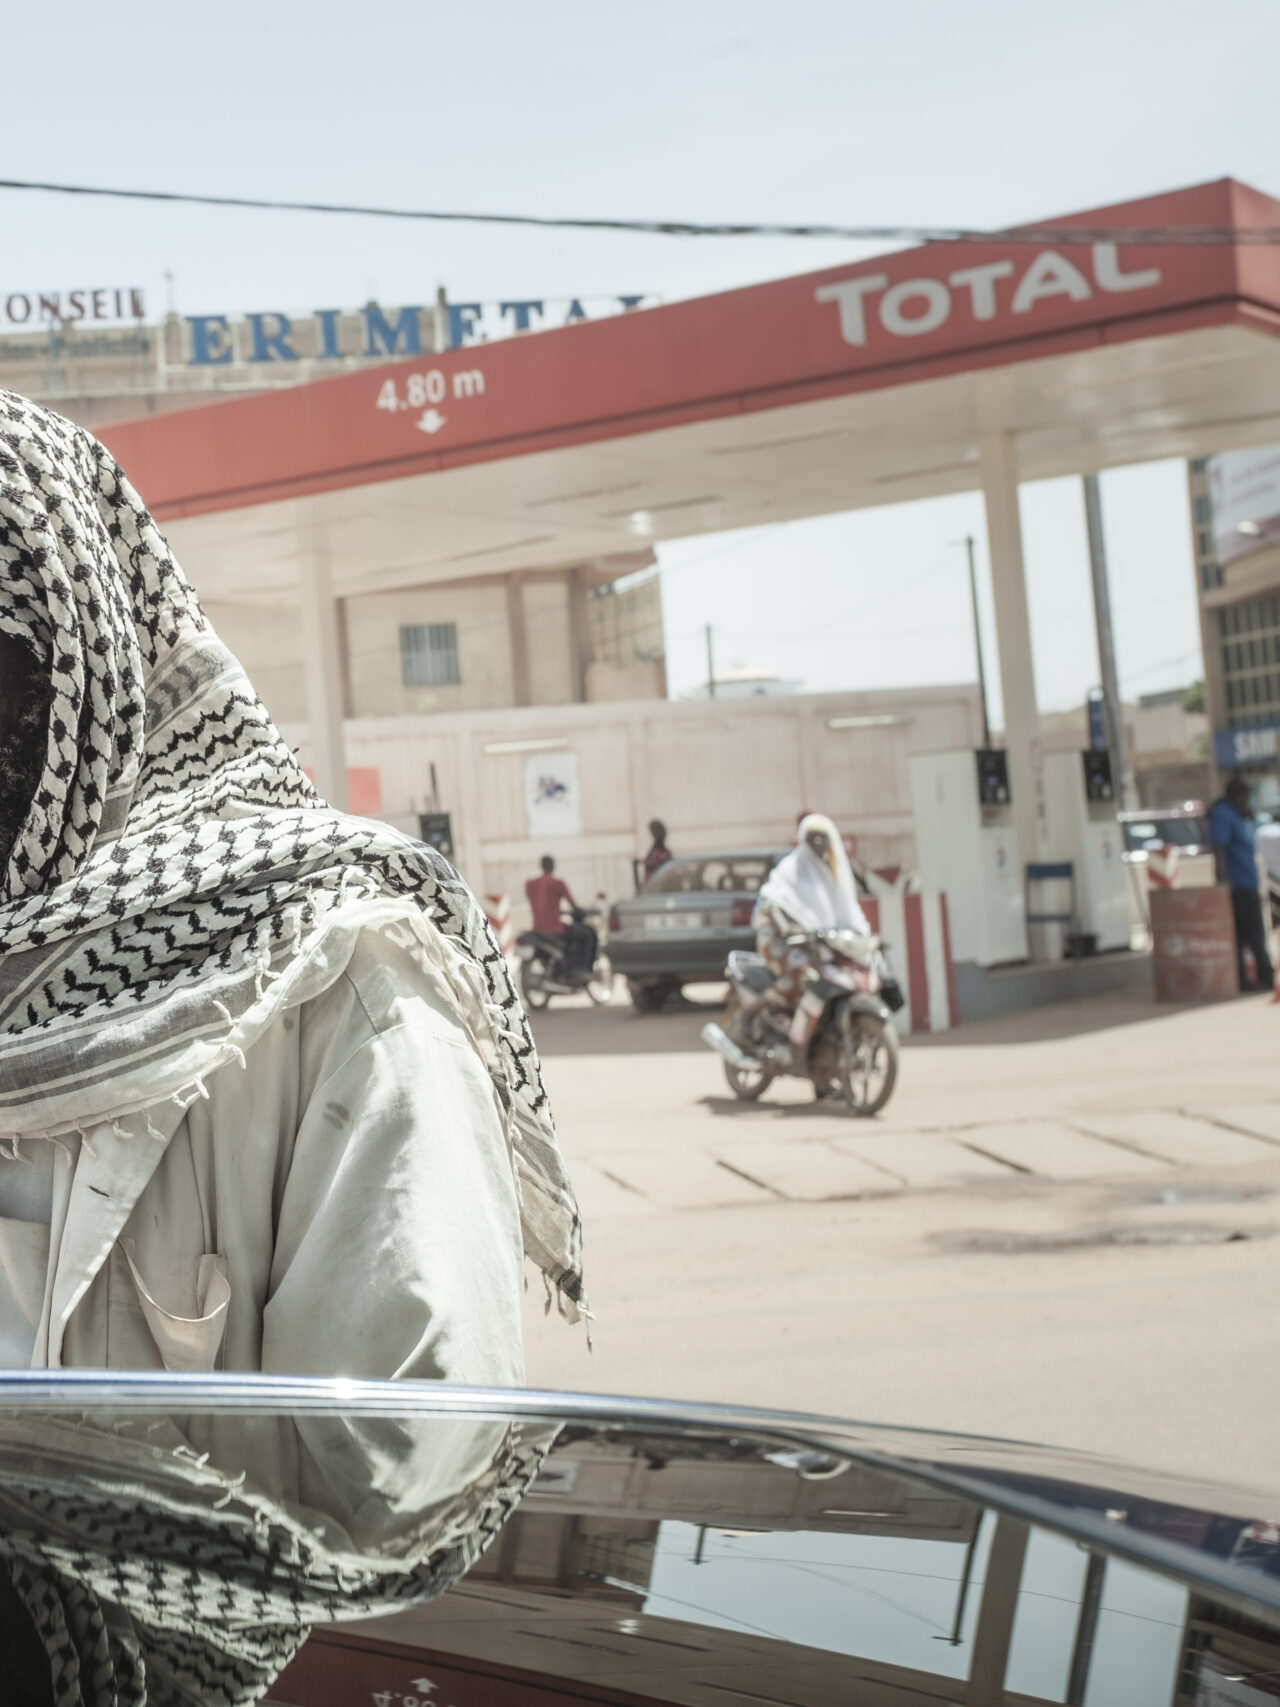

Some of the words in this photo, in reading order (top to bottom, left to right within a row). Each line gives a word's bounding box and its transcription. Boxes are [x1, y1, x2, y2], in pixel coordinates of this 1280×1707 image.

[814, 240, 1161, 347] TOTAL
[376, 369, 446, 413] 4.80
[453, 368, 485, 399] m
